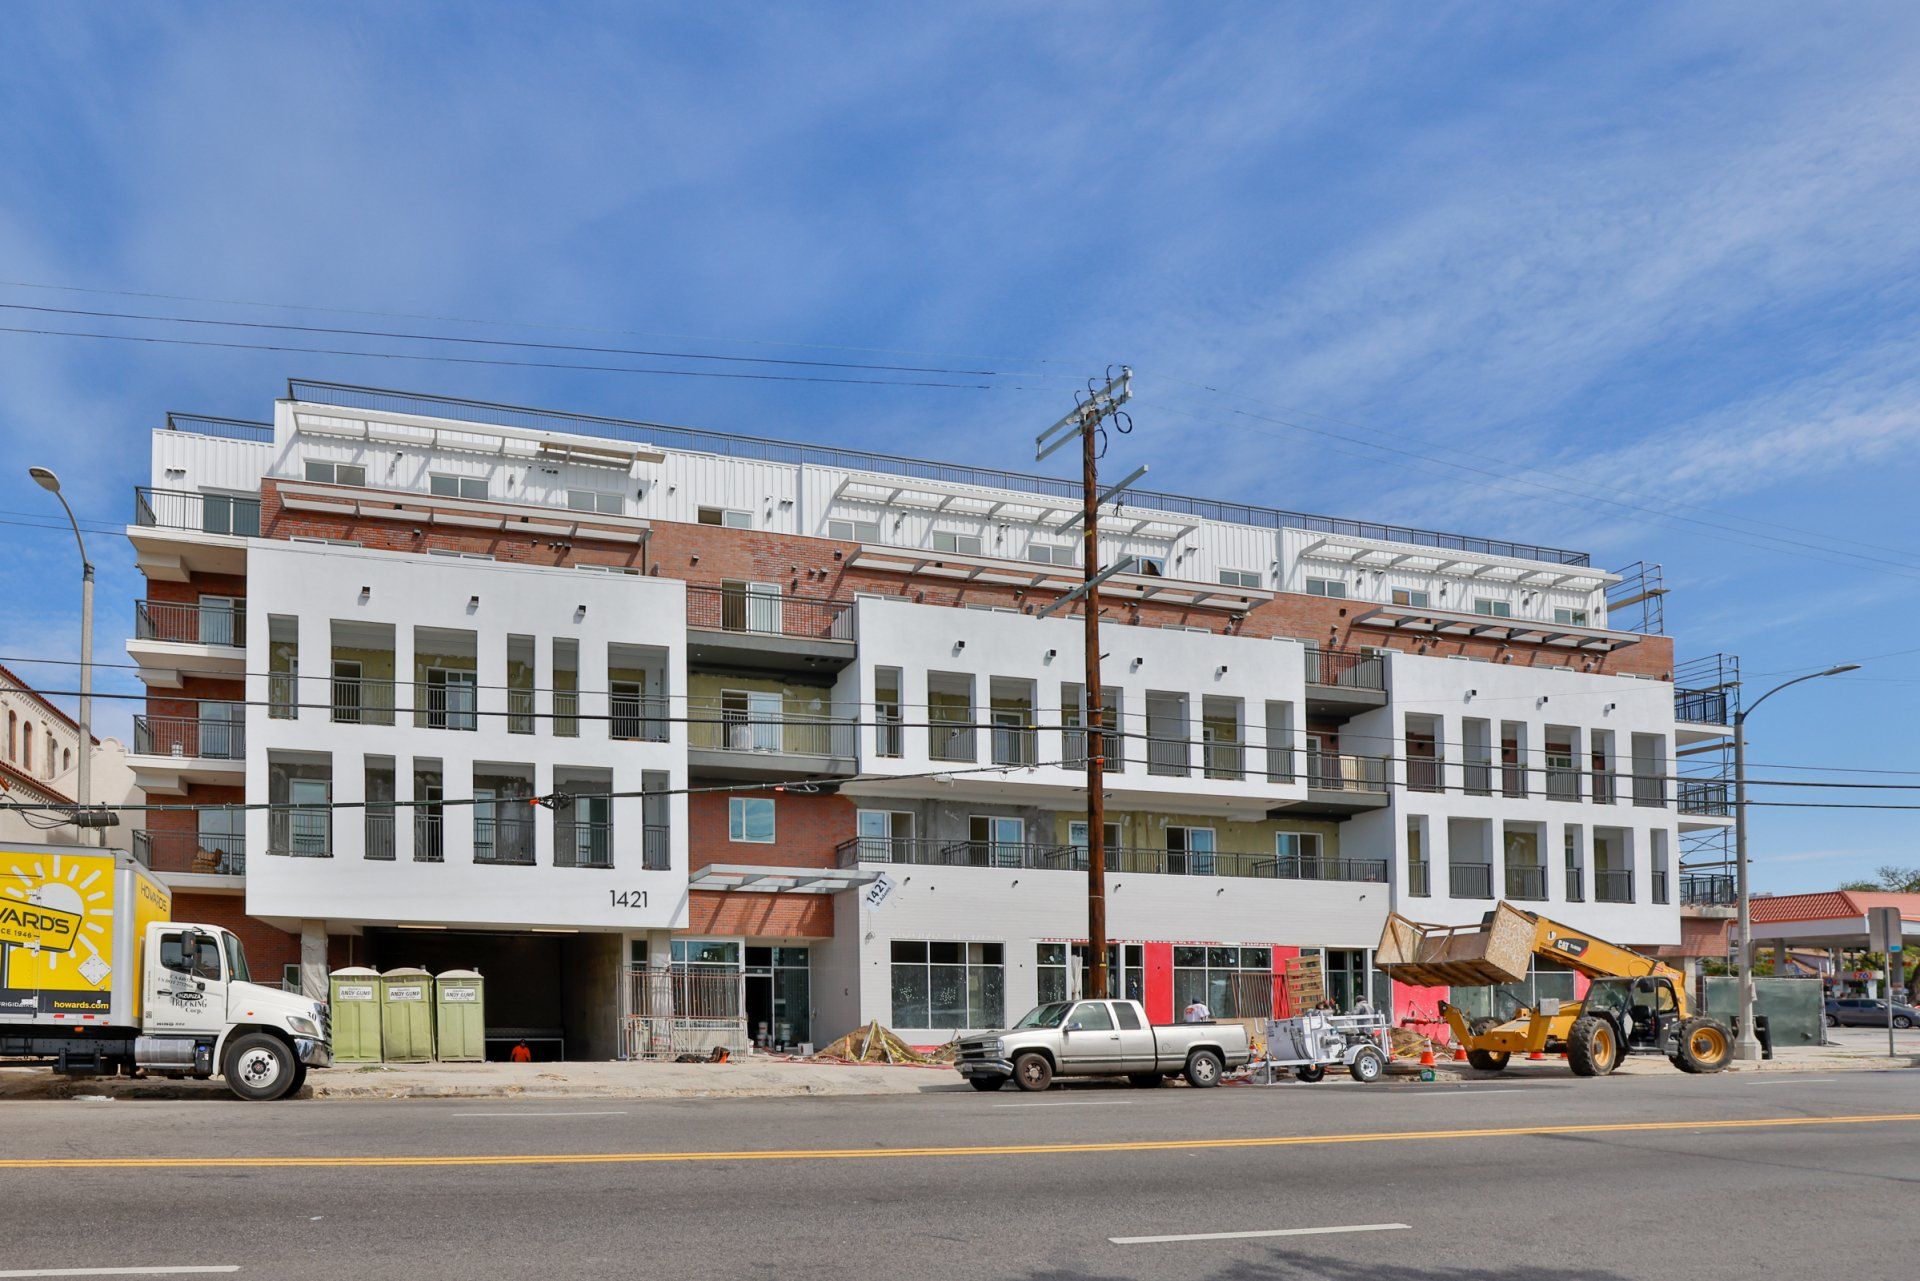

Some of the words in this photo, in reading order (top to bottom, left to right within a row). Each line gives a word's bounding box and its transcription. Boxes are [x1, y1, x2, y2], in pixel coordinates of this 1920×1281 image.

[867, 879, 887, 903] 1421
[610, 890, 647, 908] 1421
[14, 930, 32, 938] 1946
[1557, 940, 1570, 951] CAT
[54, 1001, 109, 1009] howards.com
[172, 998, 208, 1008] TRUCKING
